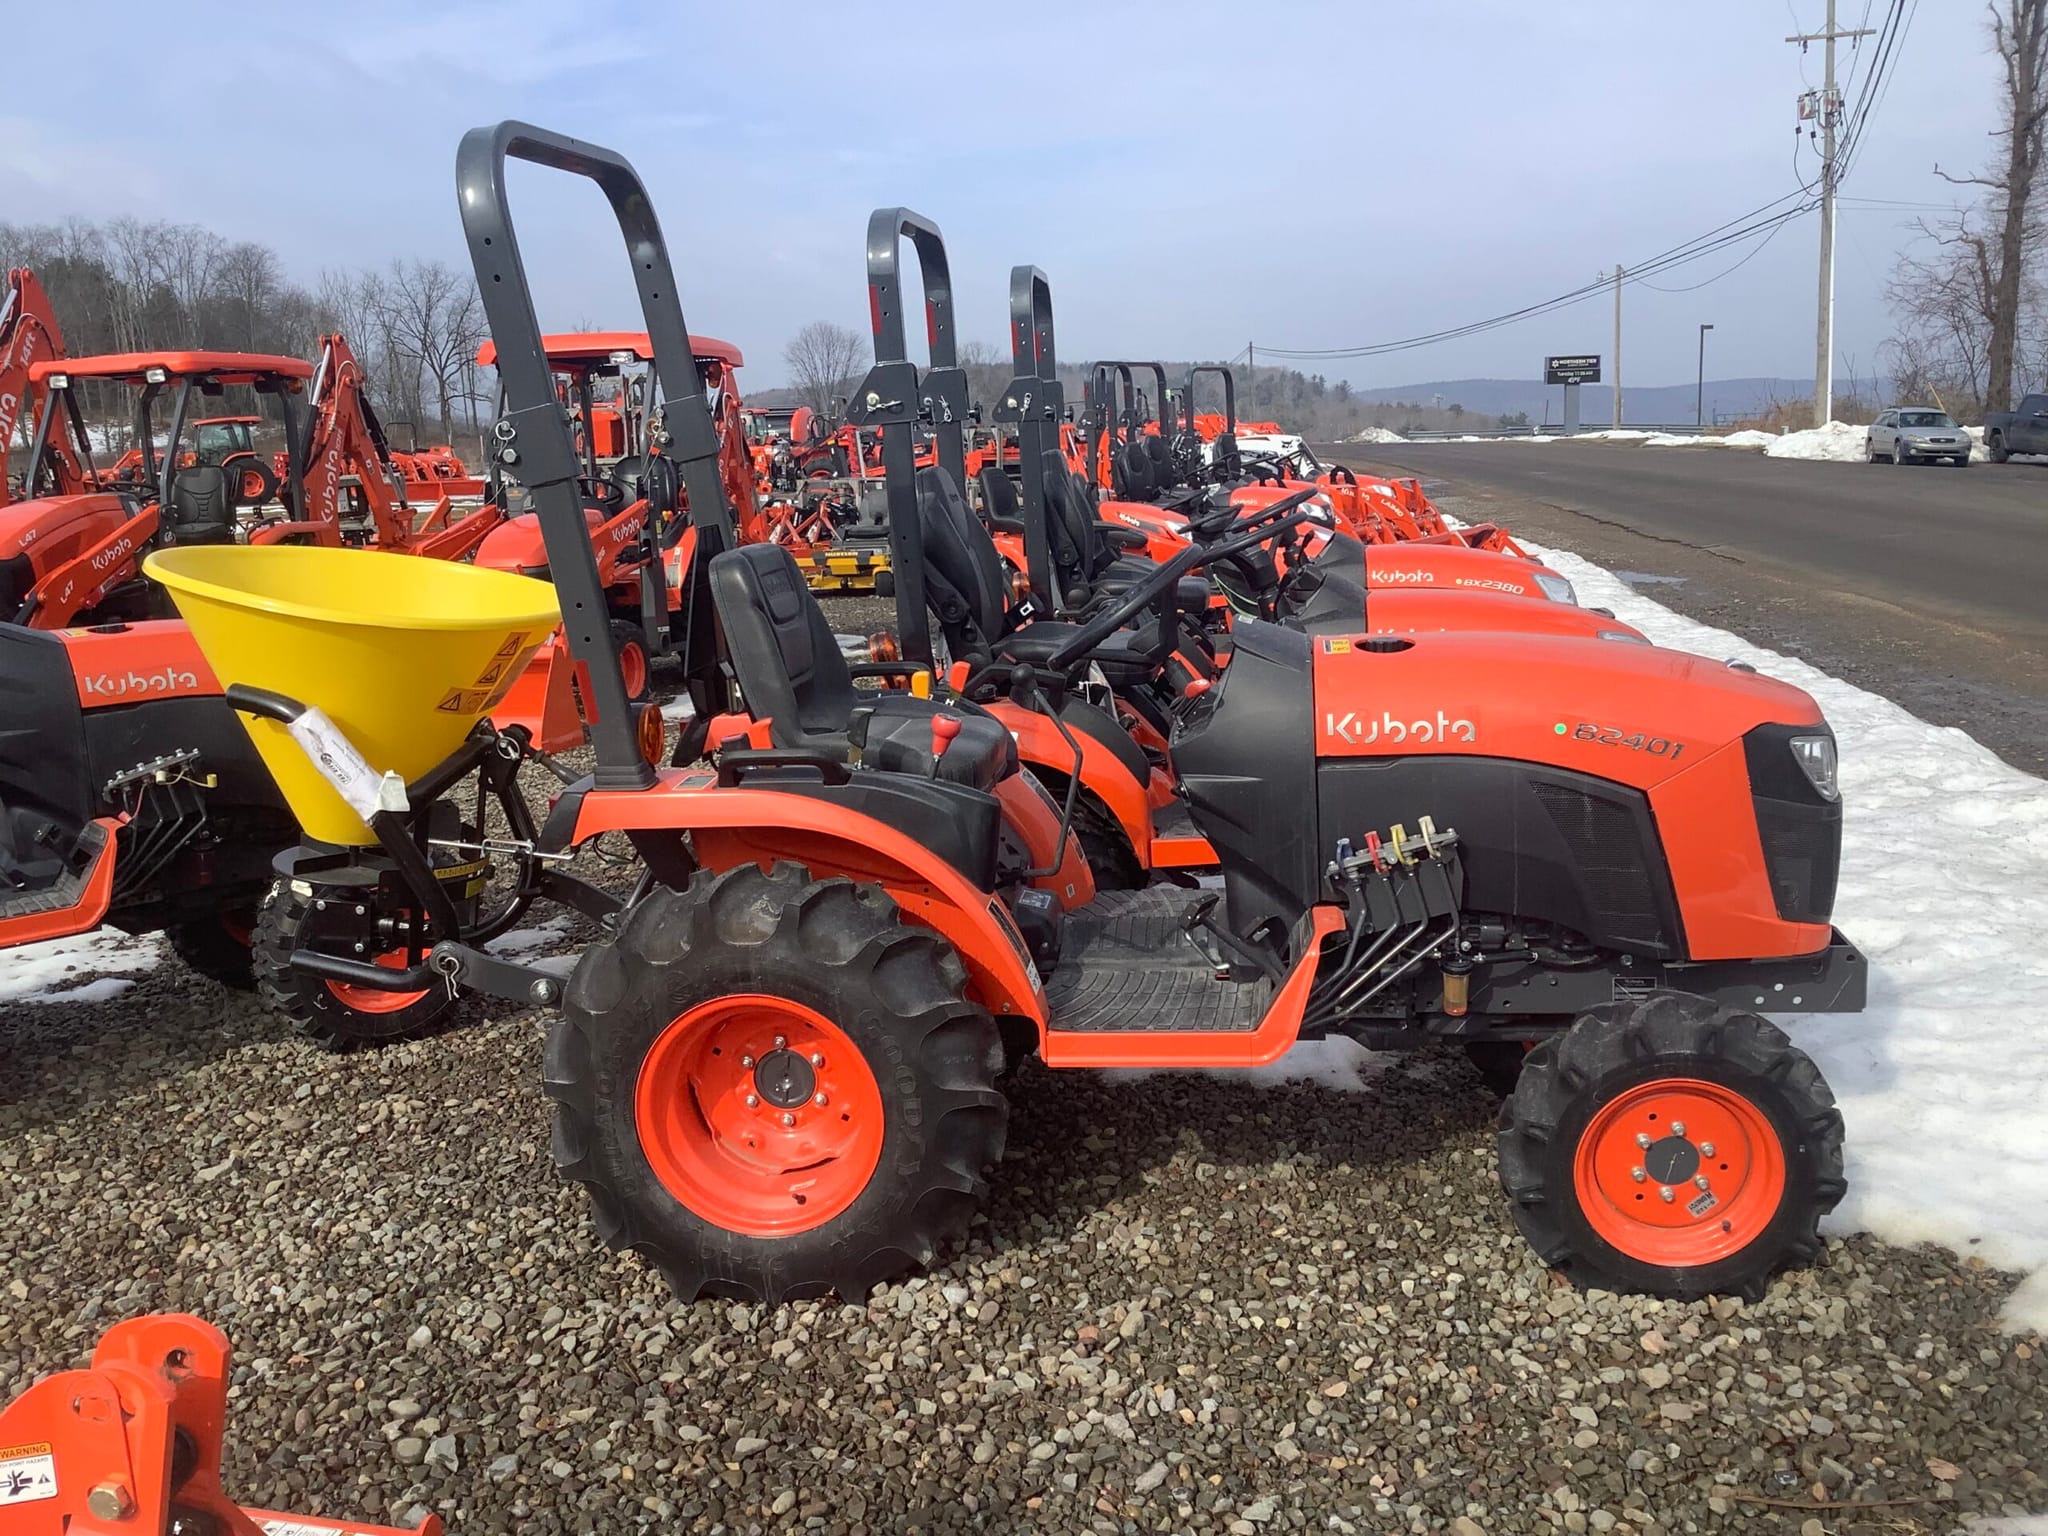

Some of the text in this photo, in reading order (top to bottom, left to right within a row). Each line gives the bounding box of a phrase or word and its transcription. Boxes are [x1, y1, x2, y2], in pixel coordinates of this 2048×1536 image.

[321, 449, 338, 523] Kubota
[18, 529, 37, 547] L47
[612, 517, 640, 543] Kubota
[91, 537, 132, 571] Kubota
[1371, 569, 1434, 584] Kubota
[1463, 578, 1525, 595] BX2380
[60, 579, 75, 605] L47
[85, 667, 198, 697] Kubota
[1327, 710, 1476, 744] Kubota
[1572, 723, 1685, 760] B2401
[1, 1445, 47, 1457] WARNING
